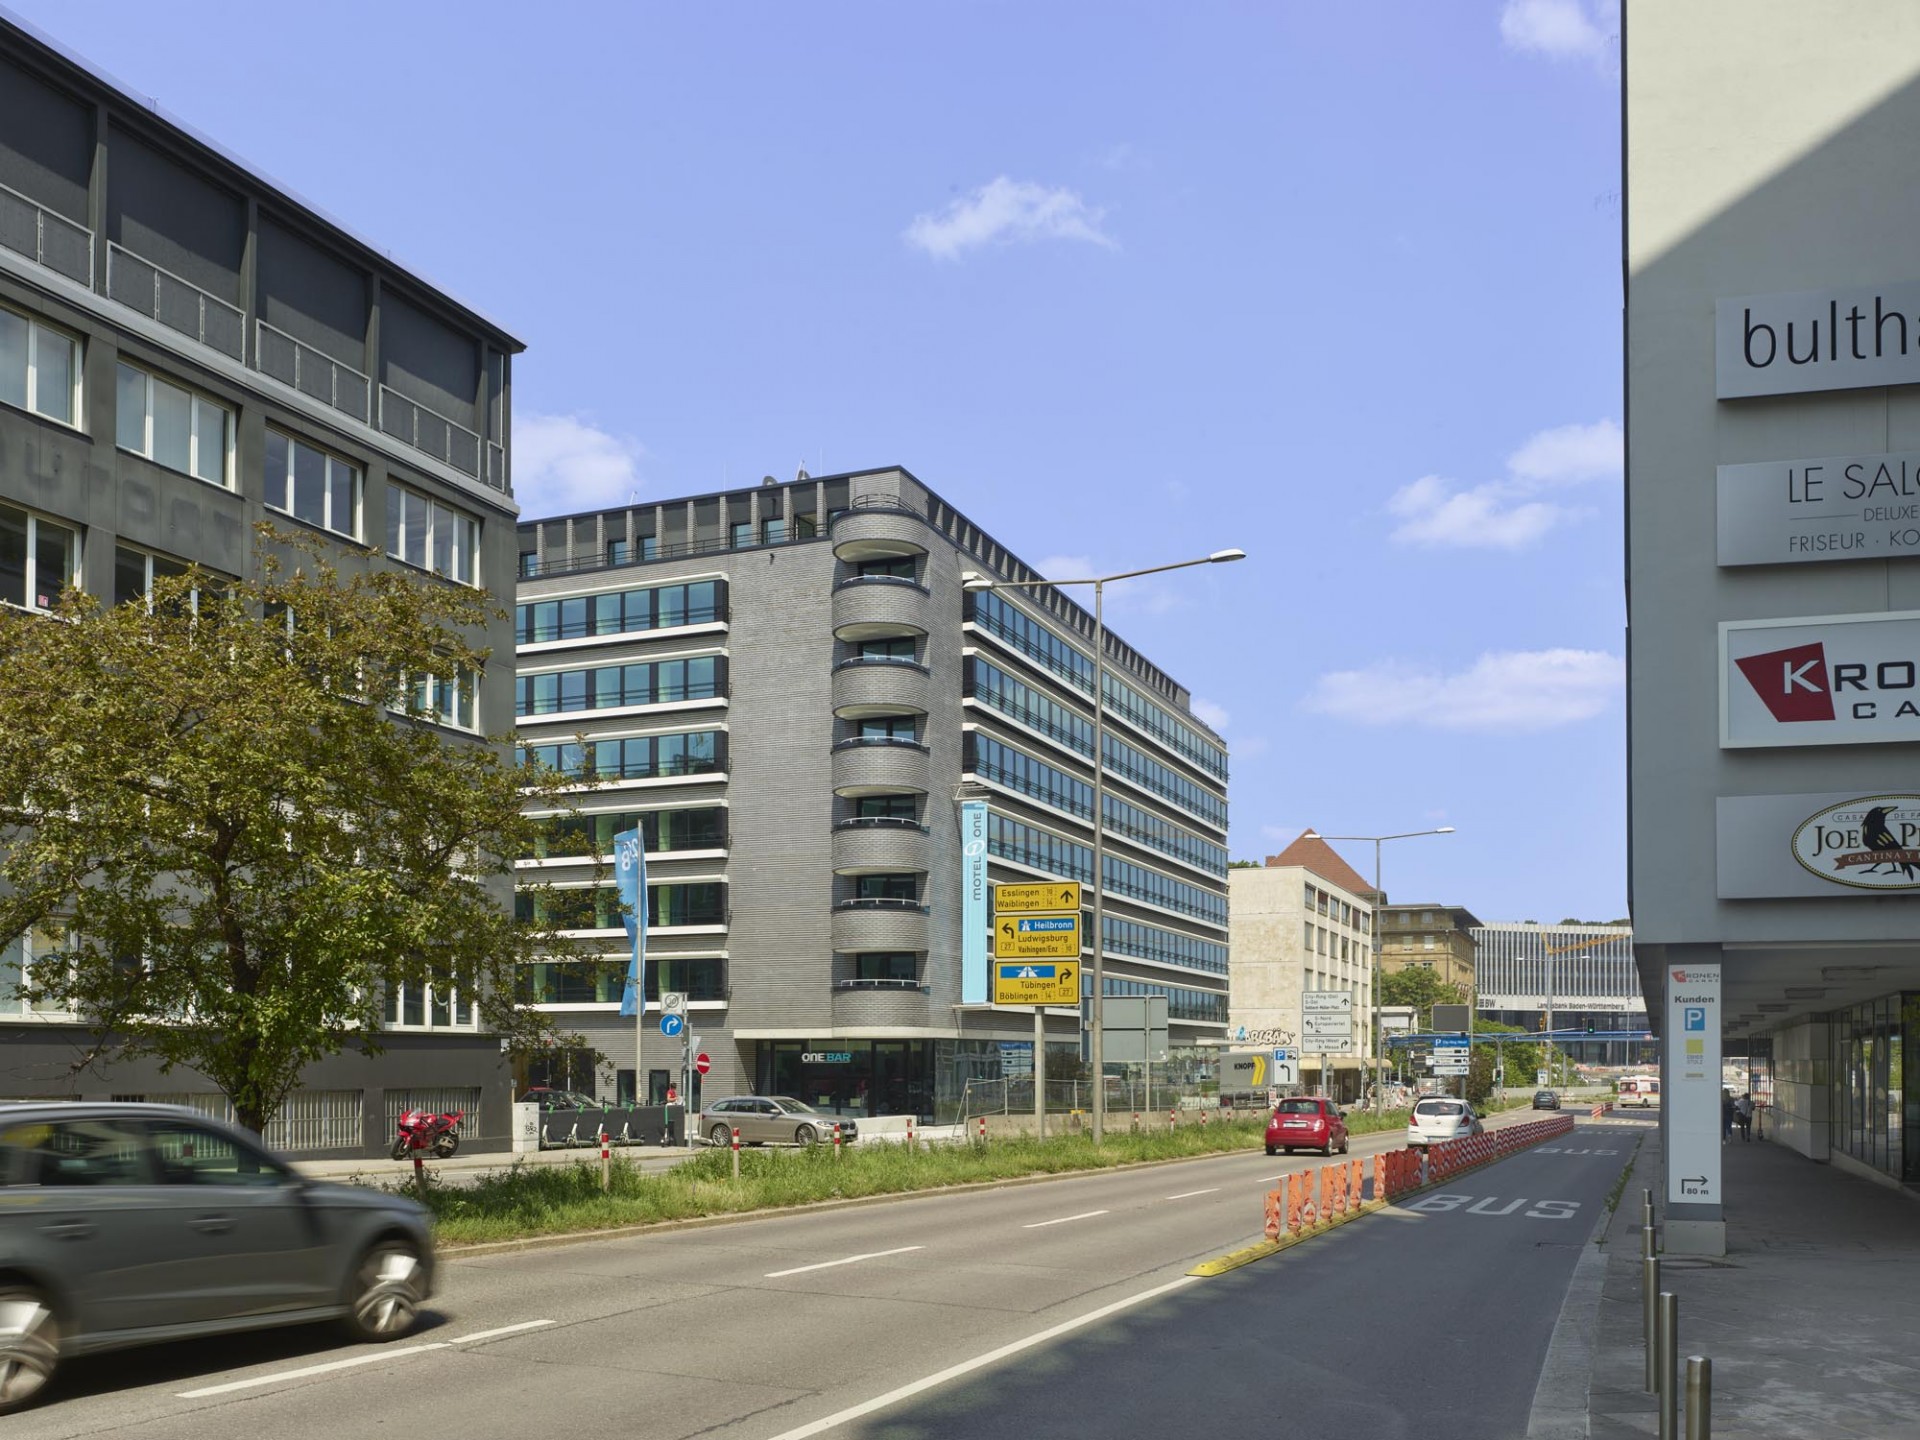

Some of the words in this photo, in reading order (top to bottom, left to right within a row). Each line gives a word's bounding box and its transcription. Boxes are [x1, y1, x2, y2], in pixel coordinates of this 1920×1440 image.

[1744, 296, 1920, 369] bulth
[1789, 467, 1824, 503] LE
[1843, 460, 1920, 500] SAL
[1863, 504, 1919, 521] DELUXE
[1789, 532, 1865, 552] FRISEUR
[1783, 660, 1915, 694] KRO
[1848, 851, 1901, 863] CANTINA
[1001, 888, 1040, 898] Esslingen
[997, 899, 1040, 909] Waiblingen
[1034, 921, 1073, 930] Heilbronn
[1017, 934, 1069, 943] Ludwigsburg
[1020, 980, 1056, 990] Tübingen
[999, 991, 1038, 1001] Böblingen
[1674, 995, 1715, 1004] Kunden
[1533, 1147, 1620, 1156] BUS
[1686, 1187, 1698, 1195] 80
[1408, 1193, 1582, 1219] BUS
